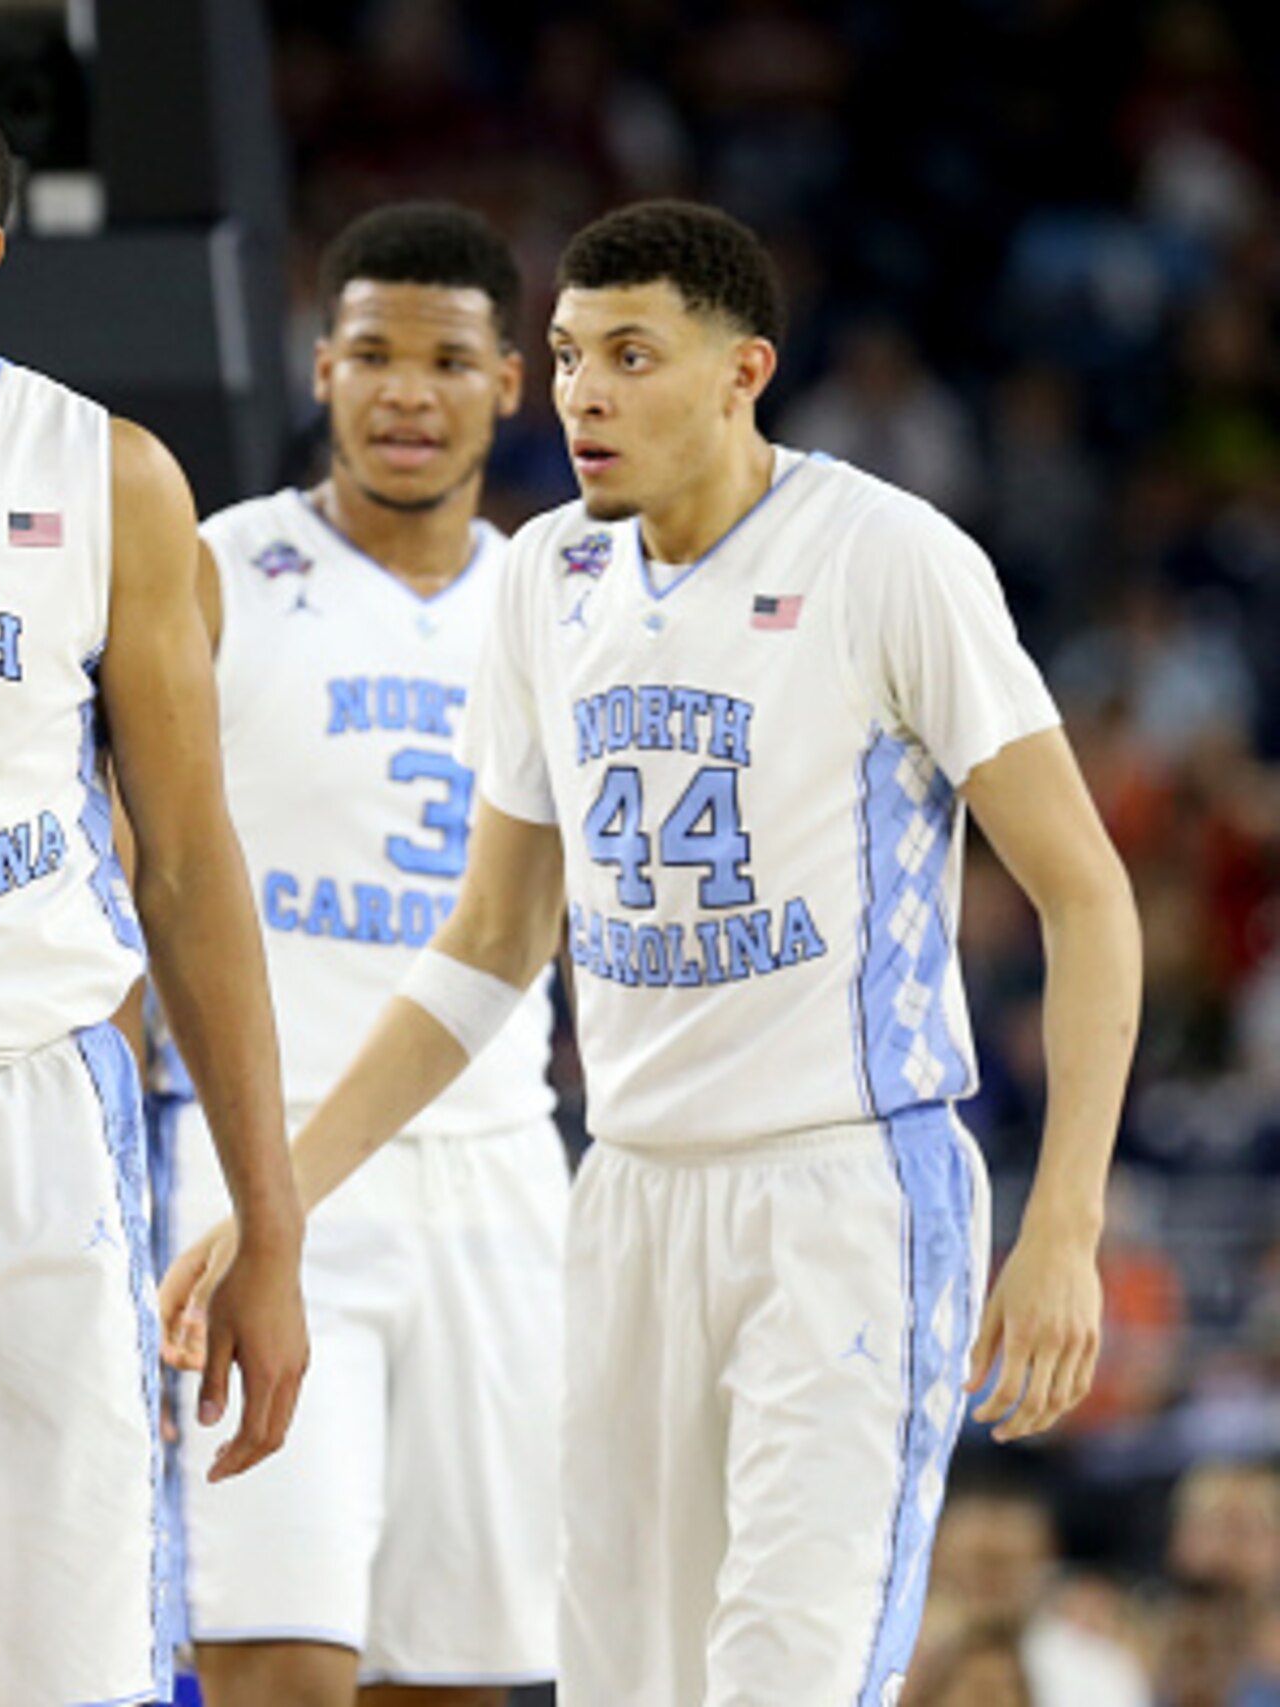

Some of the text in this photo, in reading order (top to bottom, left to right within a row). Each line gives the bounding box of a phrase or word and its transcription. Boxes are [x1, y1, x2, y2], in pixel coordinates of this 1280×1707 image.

[573, 684, 754, 768] NORTH
[384, 746, 476, 880] 3
[582, 765, 756, 910] 44
[570, 896, 828, 987] CAROLINA
